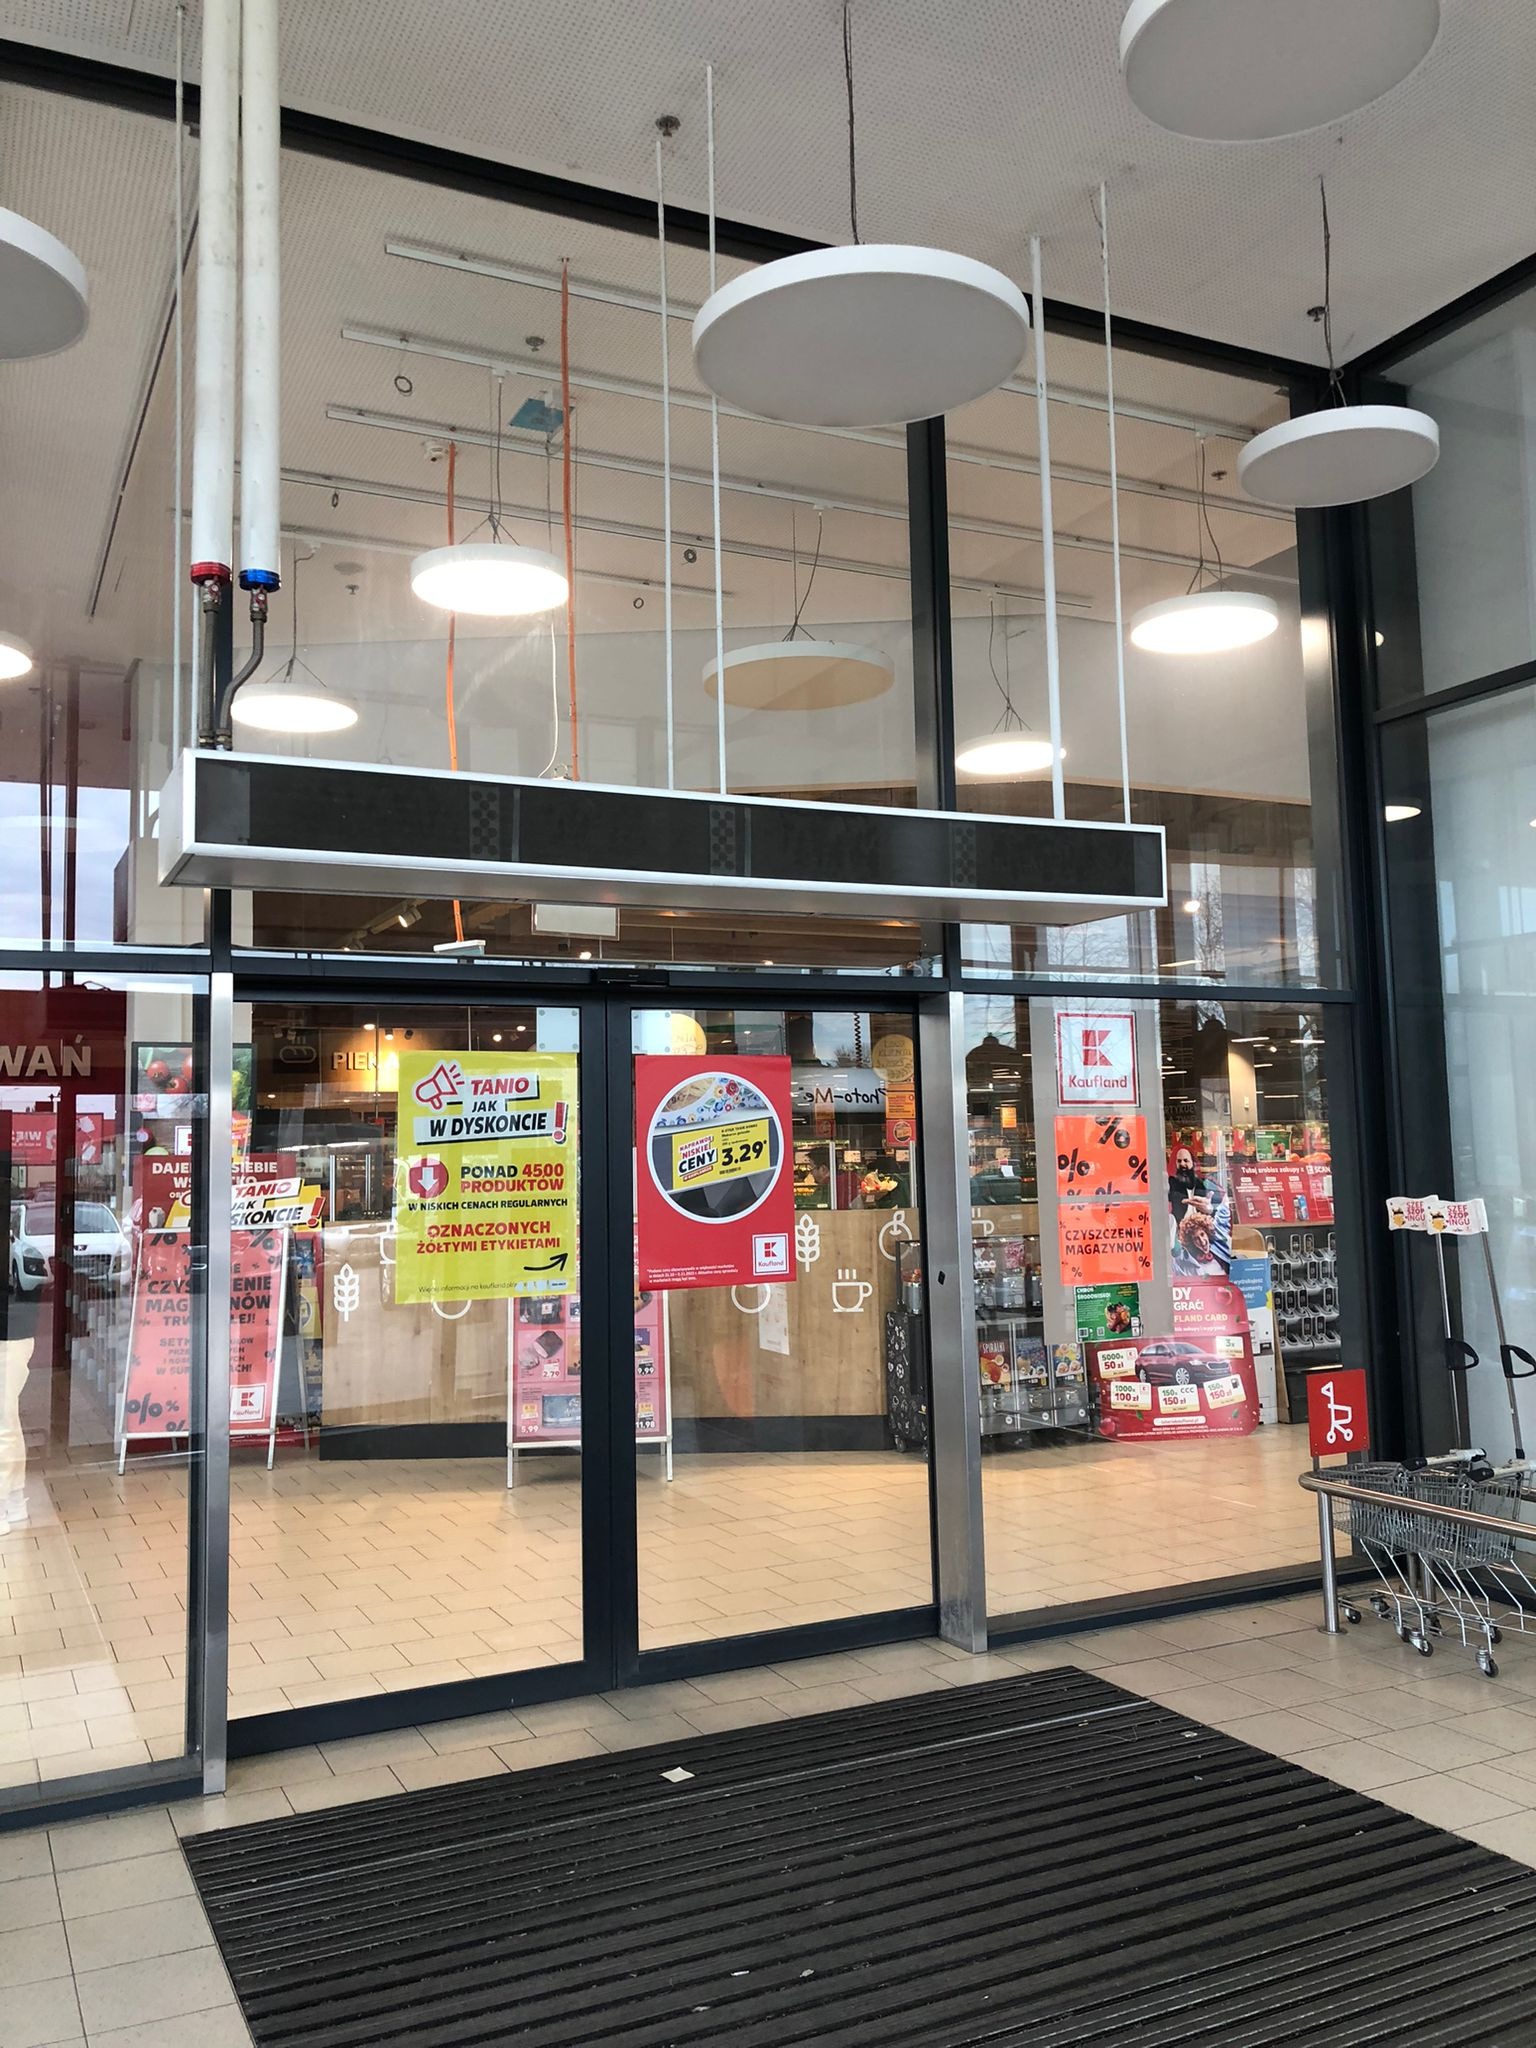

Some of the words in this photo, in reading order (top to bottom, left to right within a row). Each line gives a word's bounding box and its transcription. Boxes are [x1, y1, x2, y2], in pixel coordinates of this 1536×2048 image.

[471, 1077, 529, 1096] TANIO
[1069, 1075, 1127, 1088] Kaufland
[472, 1101, 497, 1113] JAK
[430, 1119, 447, 1137] W
[452, 1112, 547, 1136] DYSKONCIE
[679, 1149, 715, 1173] CENY
[152, 1163, 191, 1174] DAJE
[460, 1166, 518, 1179] PONAD
[522, 1163, 564, 1178] 4500
[235, 1181, 293, 1198] TANIO
[460, 1176, 565, 1193] PRODUKTÓW
[408, 1203, 417, 1211] W
[420, 1202, 459, 1211] NISKICH
[461, 1201, 498, 1210] CENACH
[500, 1199, 568, 1209] REGULARNYCH
[1447, 1204, 1468, 1212] SZEF
[427, 1221, 551, 1239] OZNACZONYCH
[1065, 1227, 1144, 1241] CZYSZCZENIE
[416, 1240, 477, 1254] ŻÓŁTYMI
[480, 1238, 560, 1252] ETYKIETAMI
[1065, 1241, 1144, 1256] MAGAZYNÓW
[1172, 1287, 1191, 1300] DY
[1173, 1299, 1204, 1311] GRAĆ!
[1174, 1314, 1203, 1323] FLAND
[1205, 1313, 1228, 1321] CARD
[1104, 1361, 1116, 1370] 50
[1115, 1392, 1132, 1402] 100
[1163, 1397, 1179, 1405] 150
